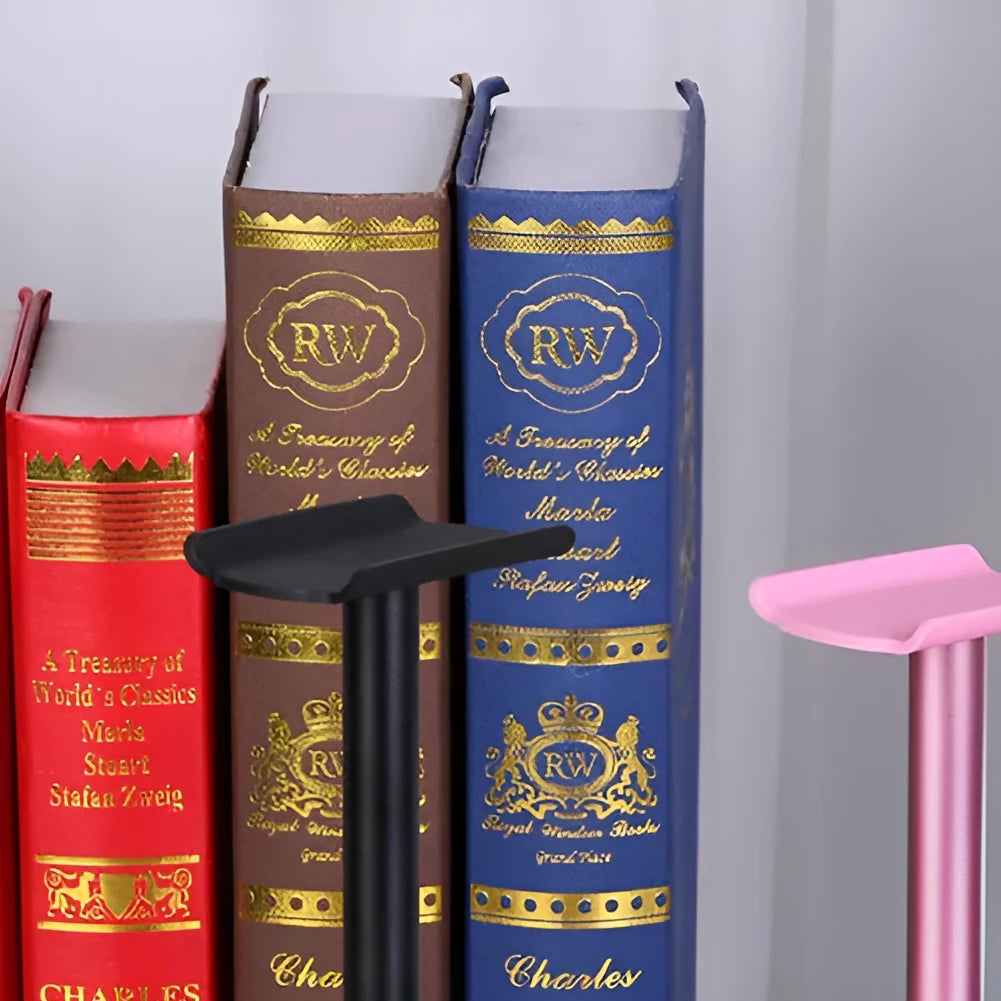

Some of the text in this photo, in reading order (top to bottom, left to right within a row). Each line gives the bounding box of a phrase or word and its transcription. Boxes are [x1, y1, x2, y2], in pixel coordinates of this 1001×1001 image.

[290, 322, 377, 367] RW
[529, 324, 616, 369] RW
[388, 423, 415, 455] of
[624, 424, 651, 456] of
[41, 649, 58, 672] A
[164, 648, 186, 673] of
[121, 683, 197, 706] Classics
[543, 751, 598, 780] RW
[504, 954, 643, 990] Charles
